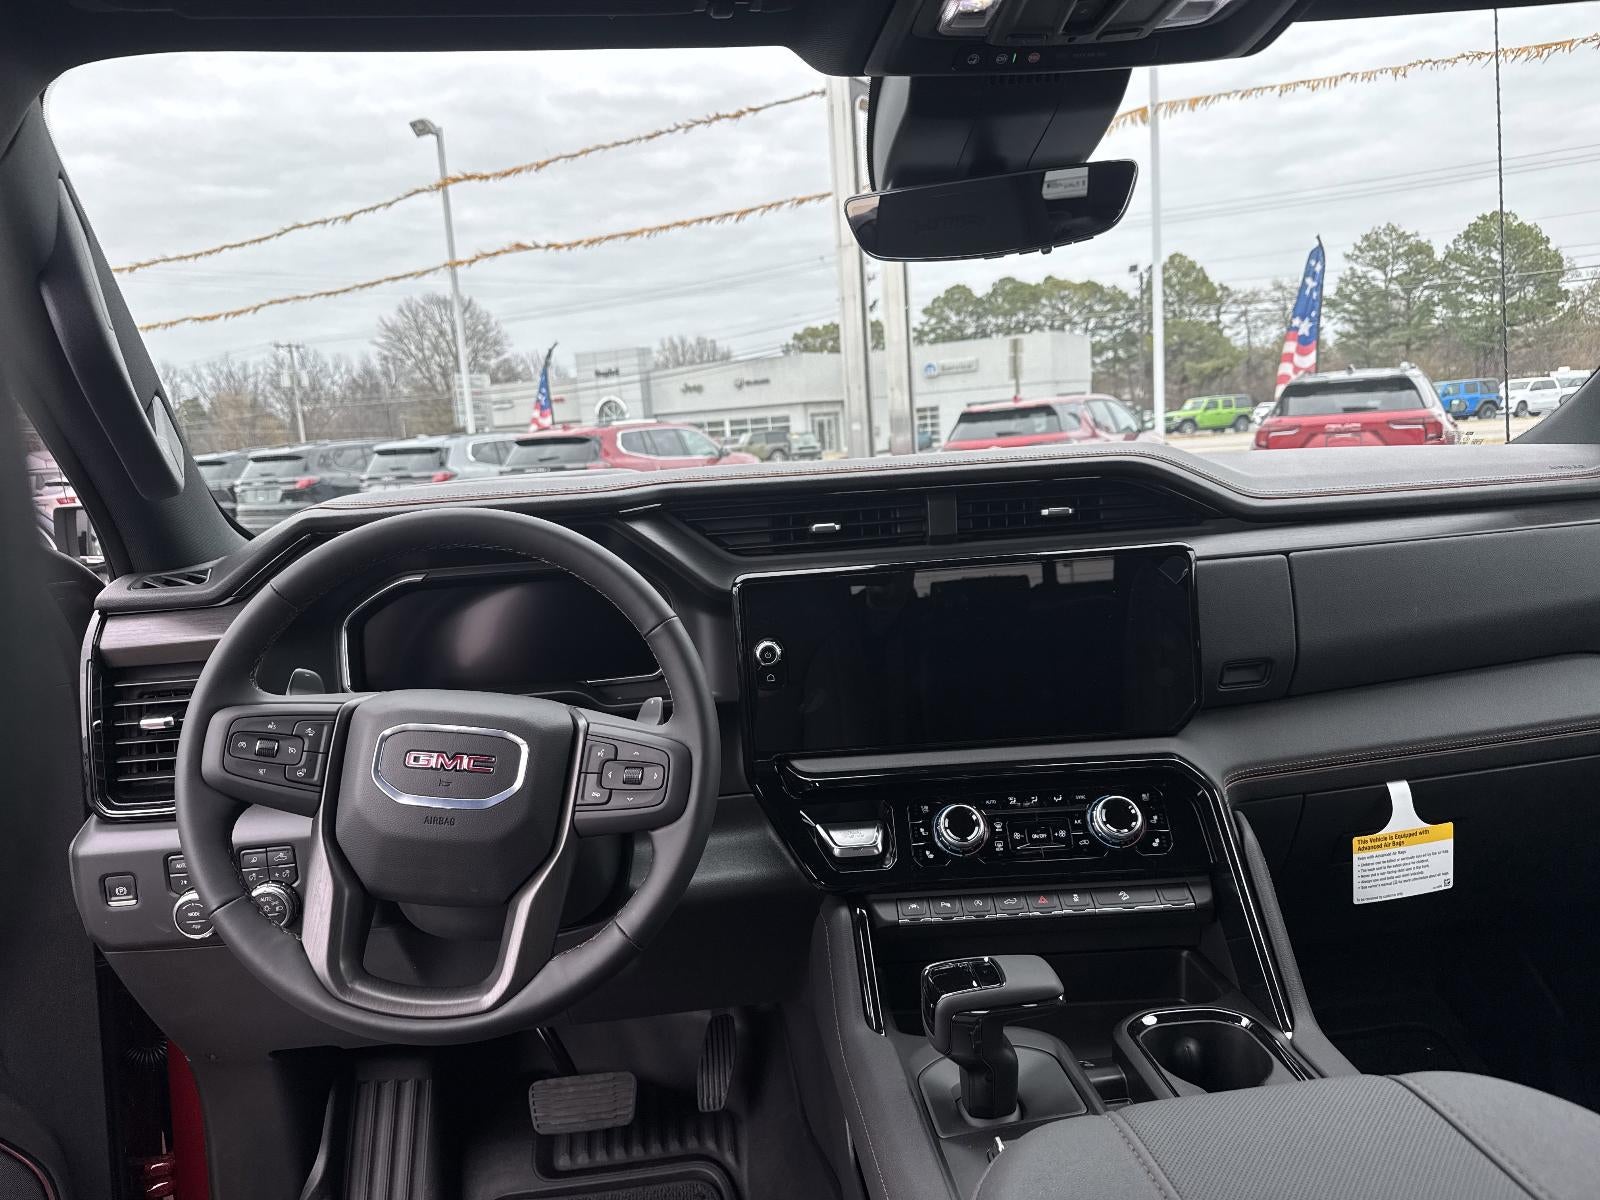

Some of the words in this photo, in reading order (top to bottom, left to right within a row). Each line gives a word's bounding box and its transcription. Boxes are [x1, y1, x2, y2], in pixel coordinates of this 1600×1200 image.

[405, 751, 496, 774] GMC
[424, 815, 456, 827] AIRBAG
[1394, 832, 1417, 840] Equipped
[1357, 843, 1382, 851] Advanced
[1392, 840, 1405, 848] Bags
